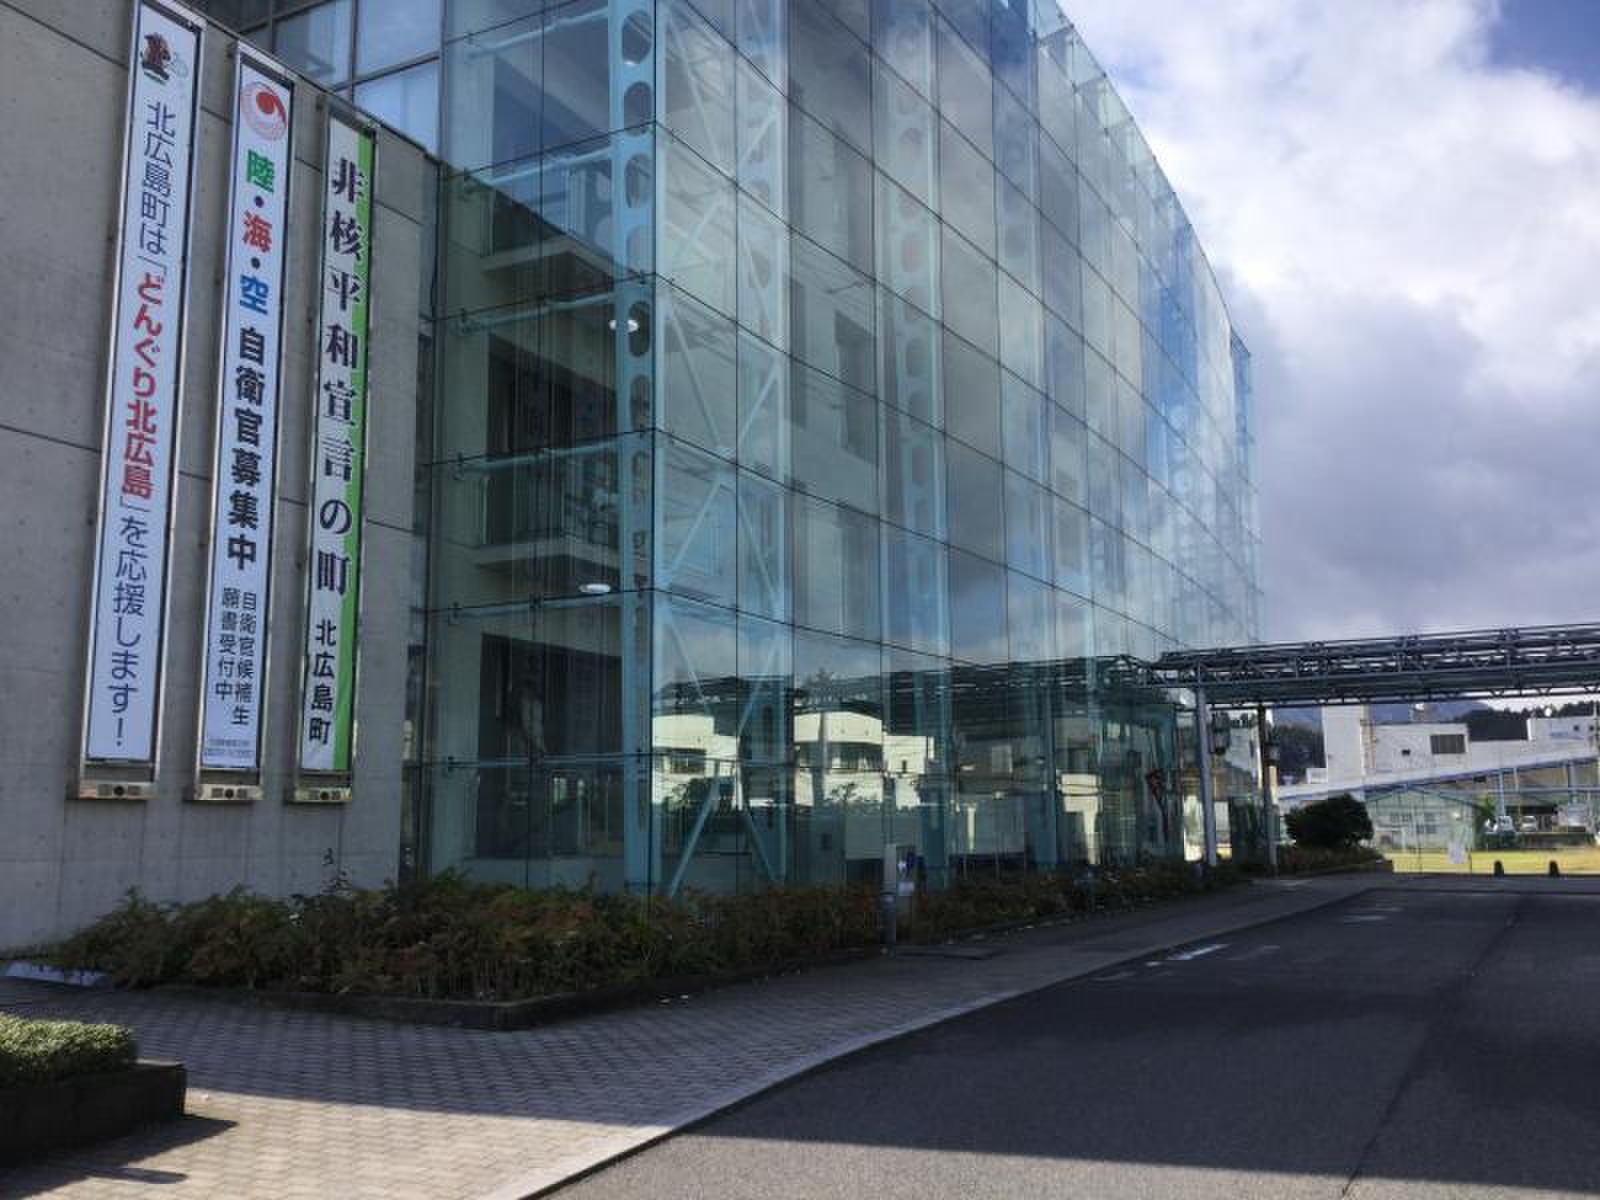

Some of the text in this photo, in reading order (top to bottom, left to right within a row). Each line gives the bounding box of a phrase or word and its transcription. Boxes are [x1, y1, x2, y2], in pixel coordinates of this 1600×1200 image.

[226, 149, 275, 571] 陸・海・空 自衛官募集中
[308, 159, 364, 745] 非核平和宣言の町 北広島町
